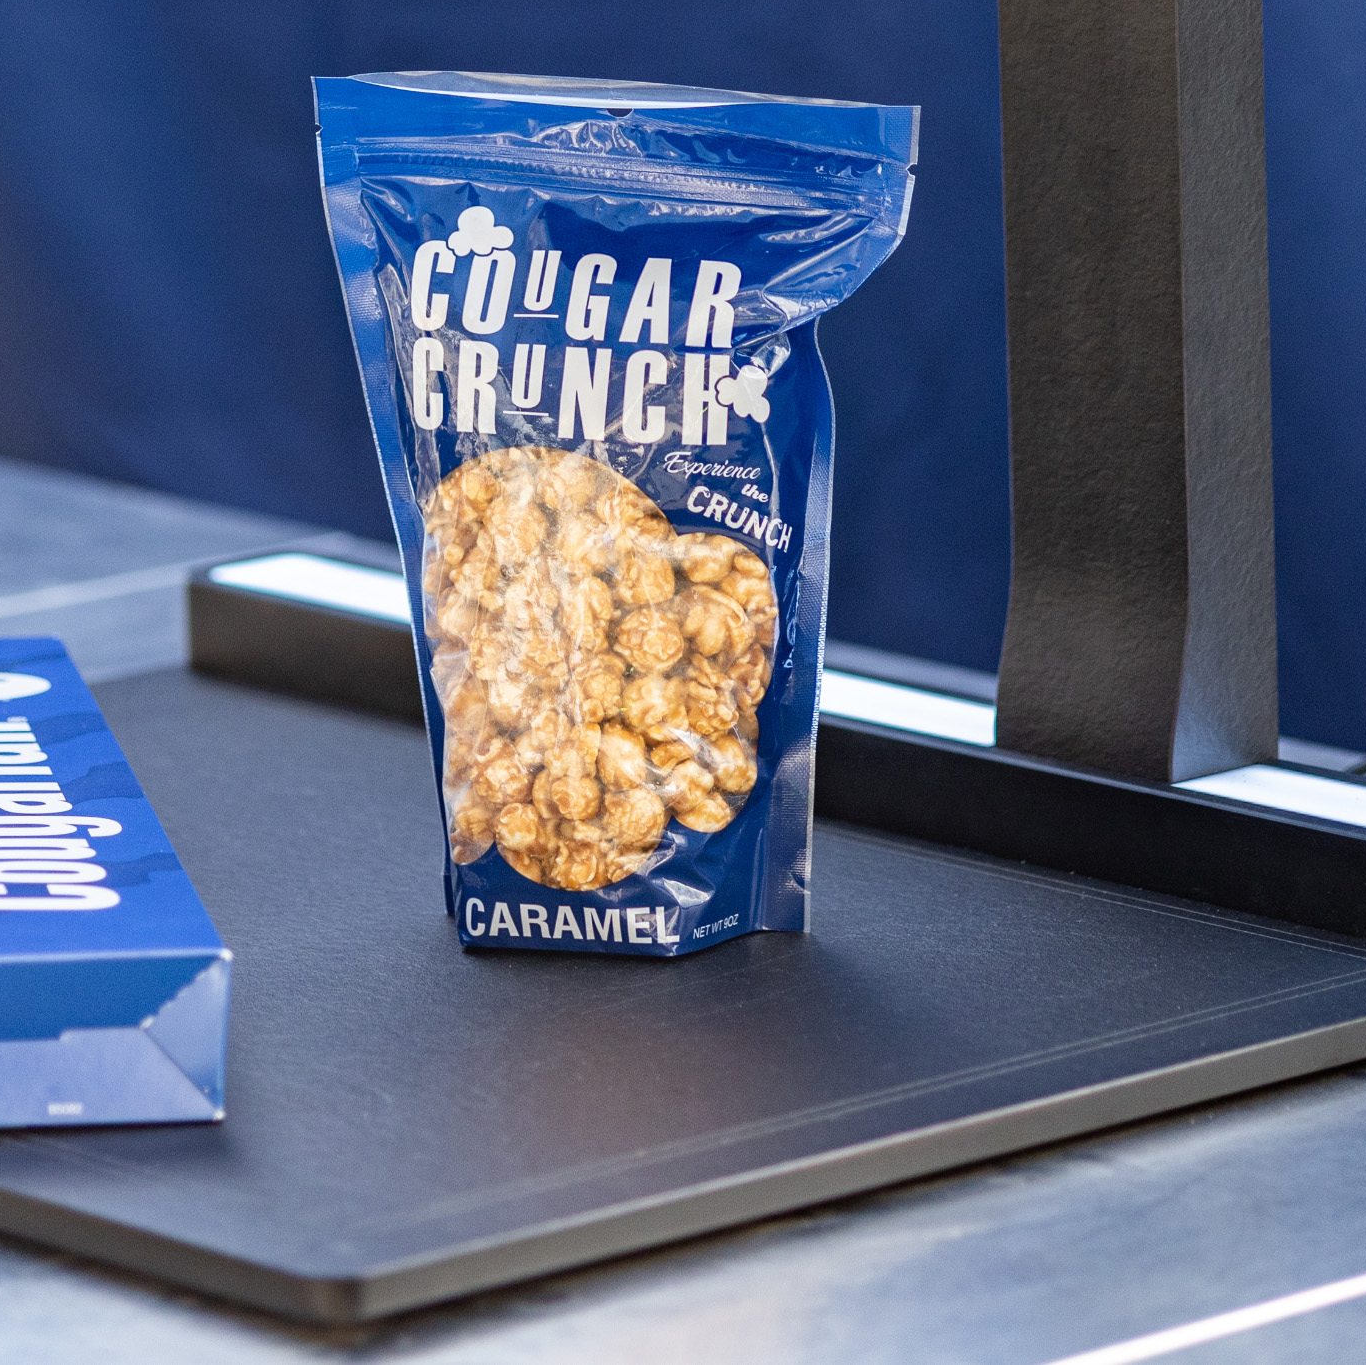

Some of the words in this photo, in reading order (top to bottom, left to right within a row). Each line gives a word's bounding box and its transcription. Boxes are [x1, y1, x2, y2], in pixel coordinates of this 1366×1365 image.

[410, 239, 743, 349] COUGAR
[412, 336, 732, 446] CRUNCH
[663, 451, 761, 480] Experience
[741, 483, 770, 503] the
[686, 485, 794, 554] CRUNCH
[465, 897, 680, 945] CARAMEL
[692, 924, 711, 940] NET
[711, 919, 724, 934] WT
